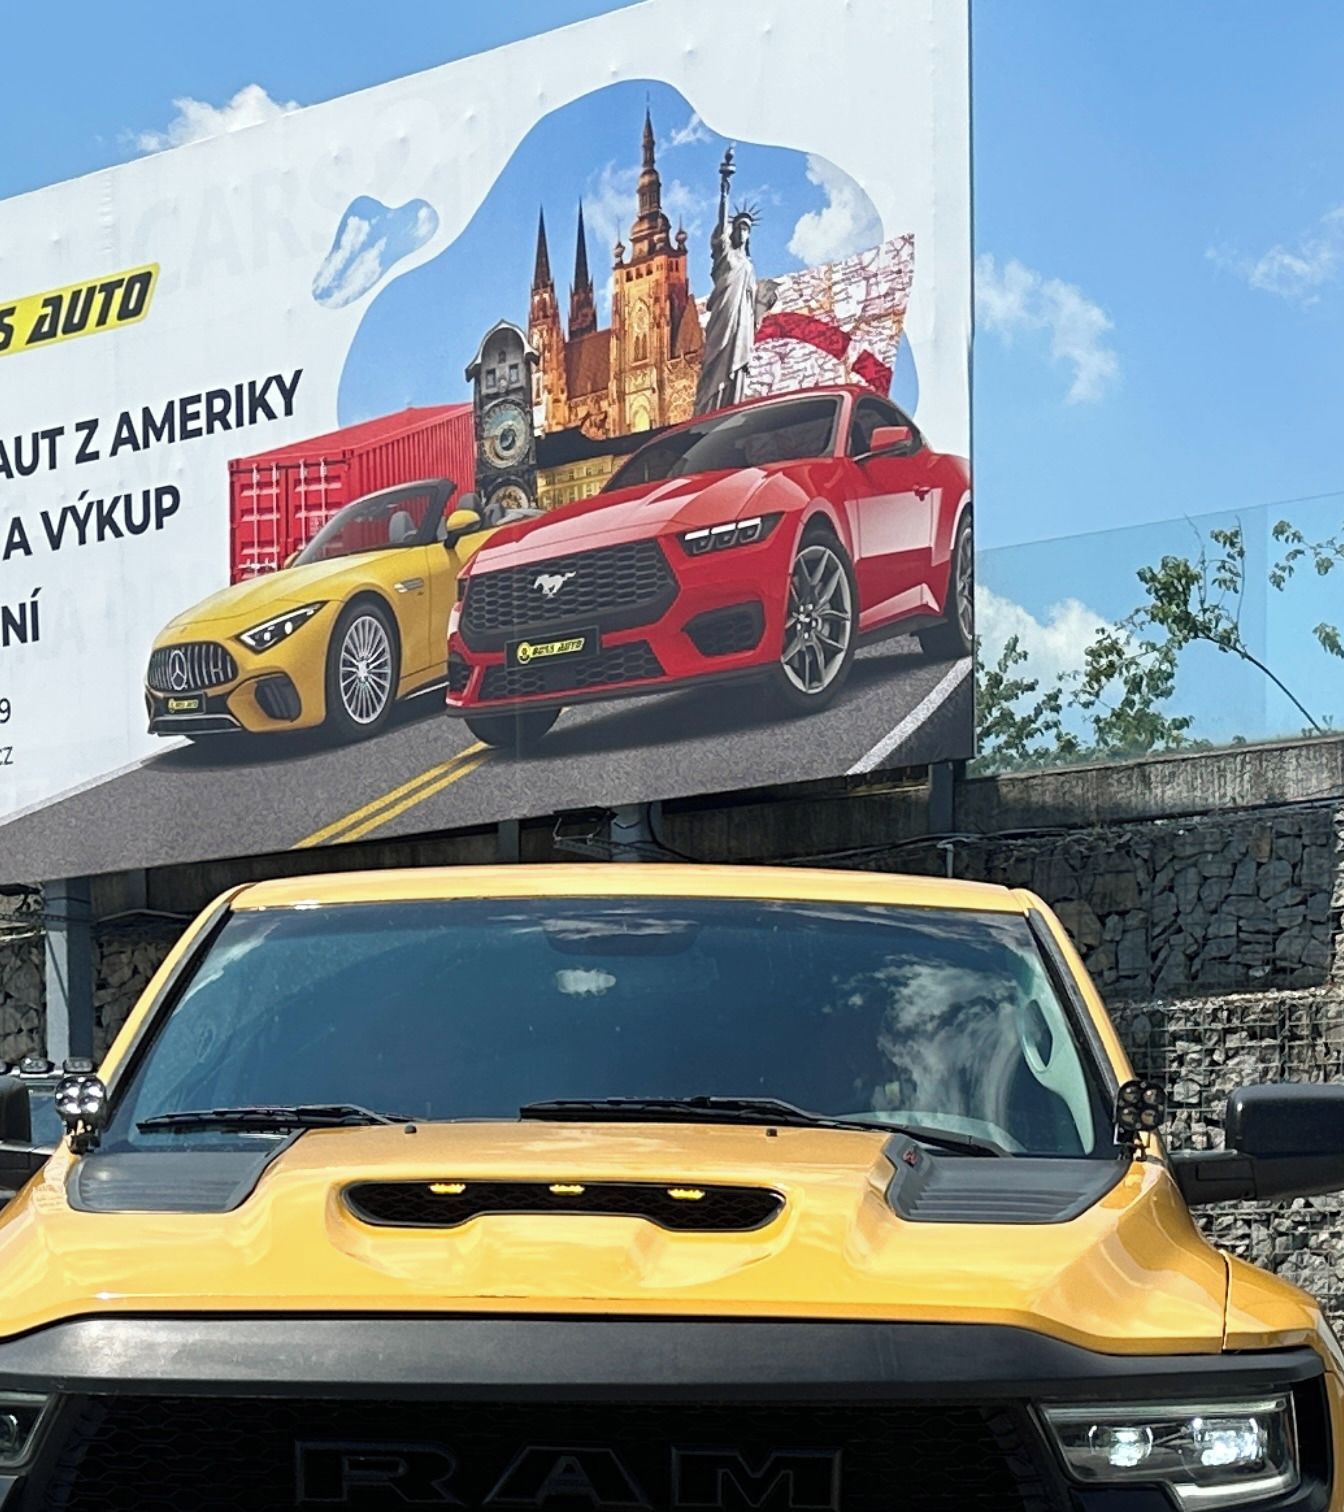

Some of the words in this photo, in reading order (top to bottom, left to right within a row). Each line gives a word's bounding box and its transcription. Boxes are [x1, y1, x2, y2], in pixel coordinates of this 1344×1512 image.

[25, 270, 153, 346] AUTO
[75, 417, 100, 465] Z
[109, 368, 304, 458] AMERIKY
[2, 516, 33, 561] A
[39, 485, 181, 551] VÝKUP
